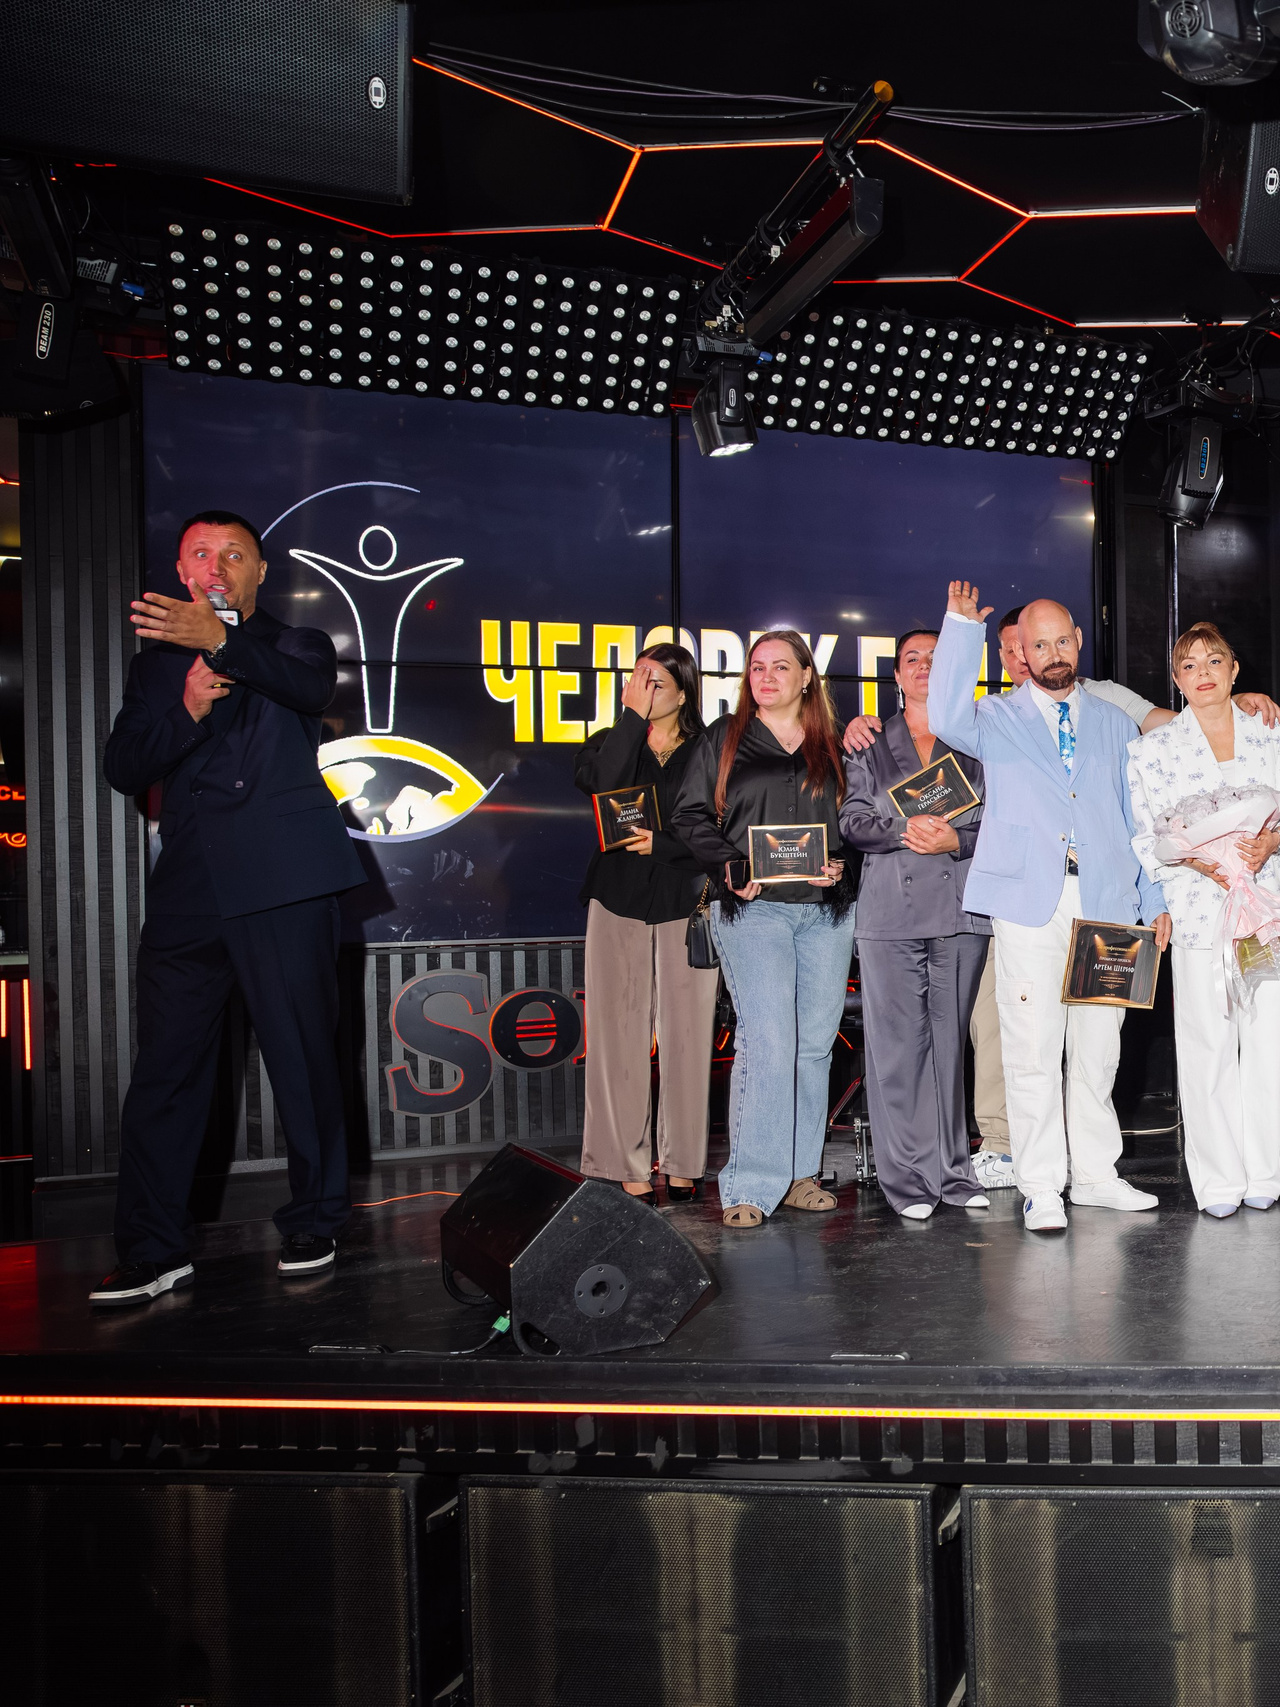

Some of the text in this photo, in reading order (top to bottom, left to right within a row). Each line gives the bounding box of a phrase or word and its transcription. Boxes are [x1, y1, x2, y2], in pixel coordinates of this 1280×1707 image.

[38, 309, 52, 352] BEAM 230
[919, 784, 945, 802] ОКСАНА
[917, 787, 953, 810] ГЕРАСЬКОВА
[620, 808, 640, 816] ДИАНА
[616, 813, 644, 823] ЖДАНОВА
[770, 851, 808, 859] БУКШТЕЙН
[1093, 963, 1135, 973] АРТЁМ ШЕРИФ
